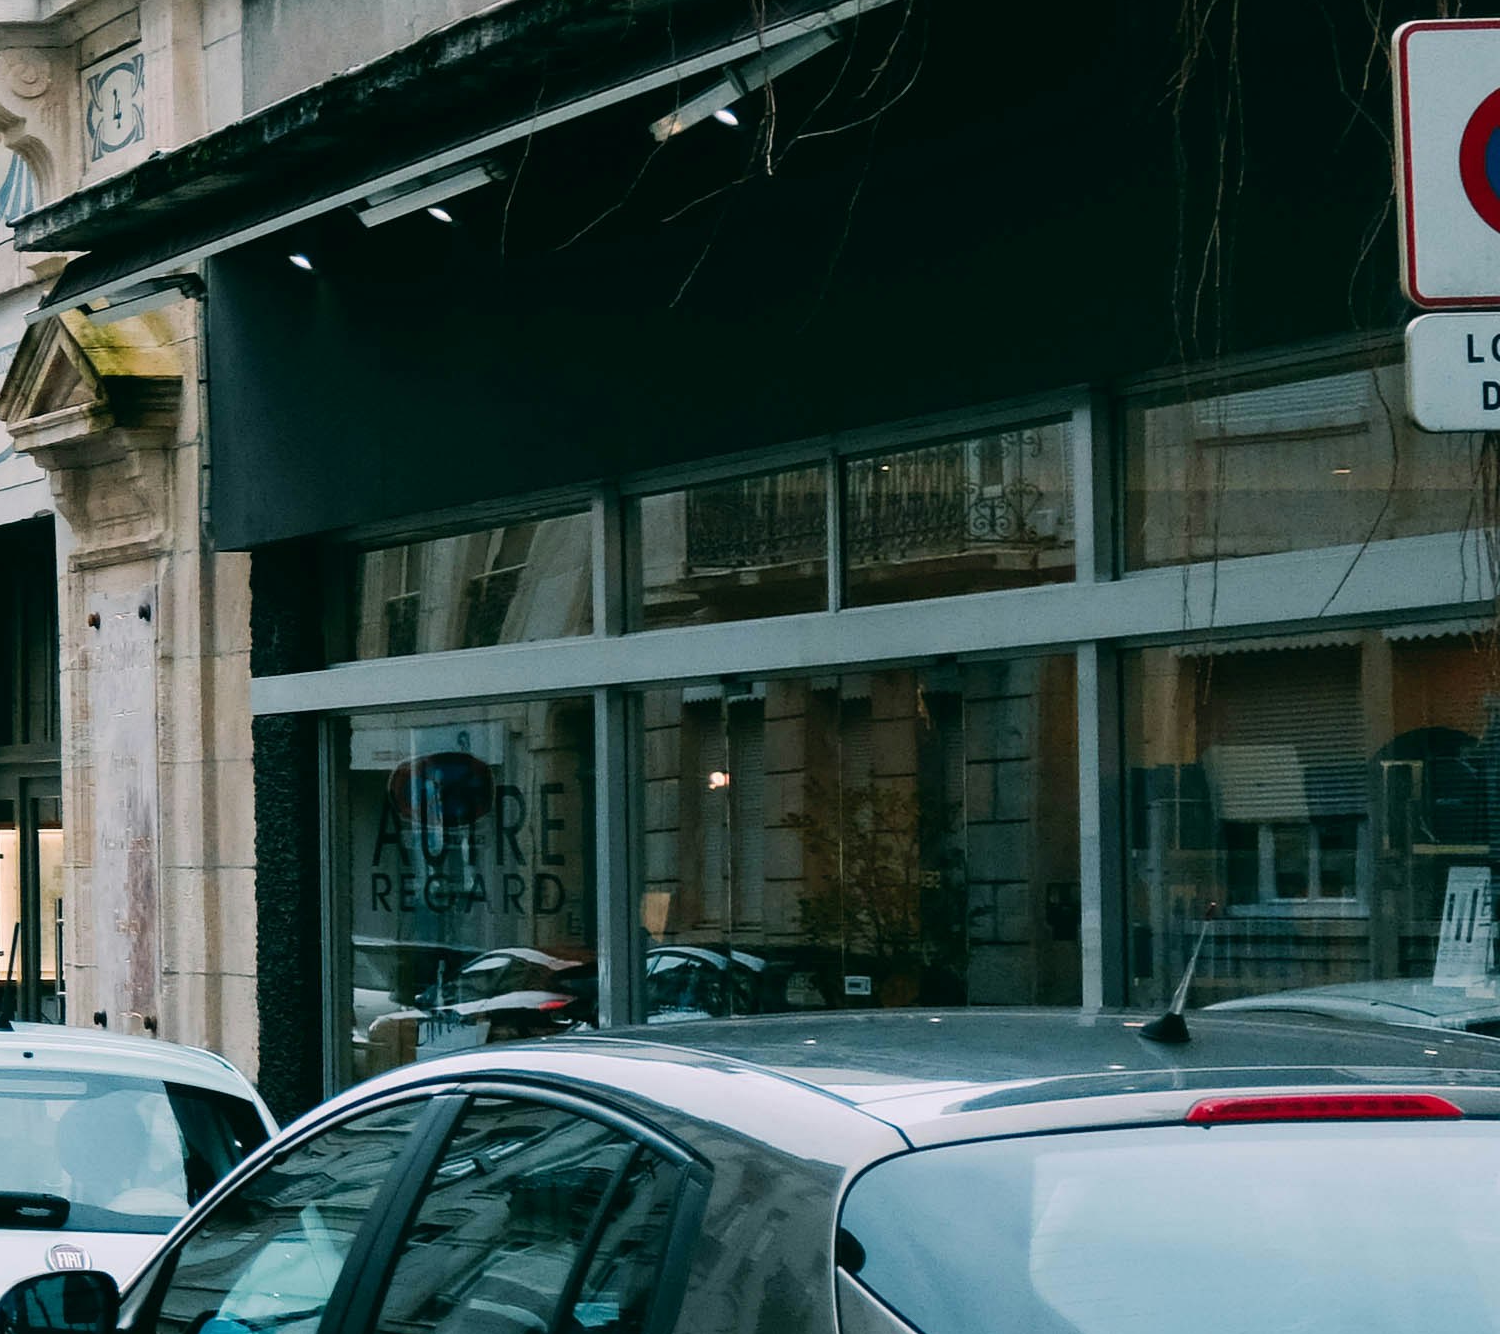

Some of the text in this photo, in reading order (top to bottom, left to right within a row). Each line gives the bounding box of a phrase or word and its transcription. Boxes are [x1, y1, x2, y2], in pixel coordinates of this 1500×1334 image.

[372, 778, 565, 867] AUTRE
[371, 872, 566, 916] REGARD
[56, 1251, 83, 1269] FIAT
